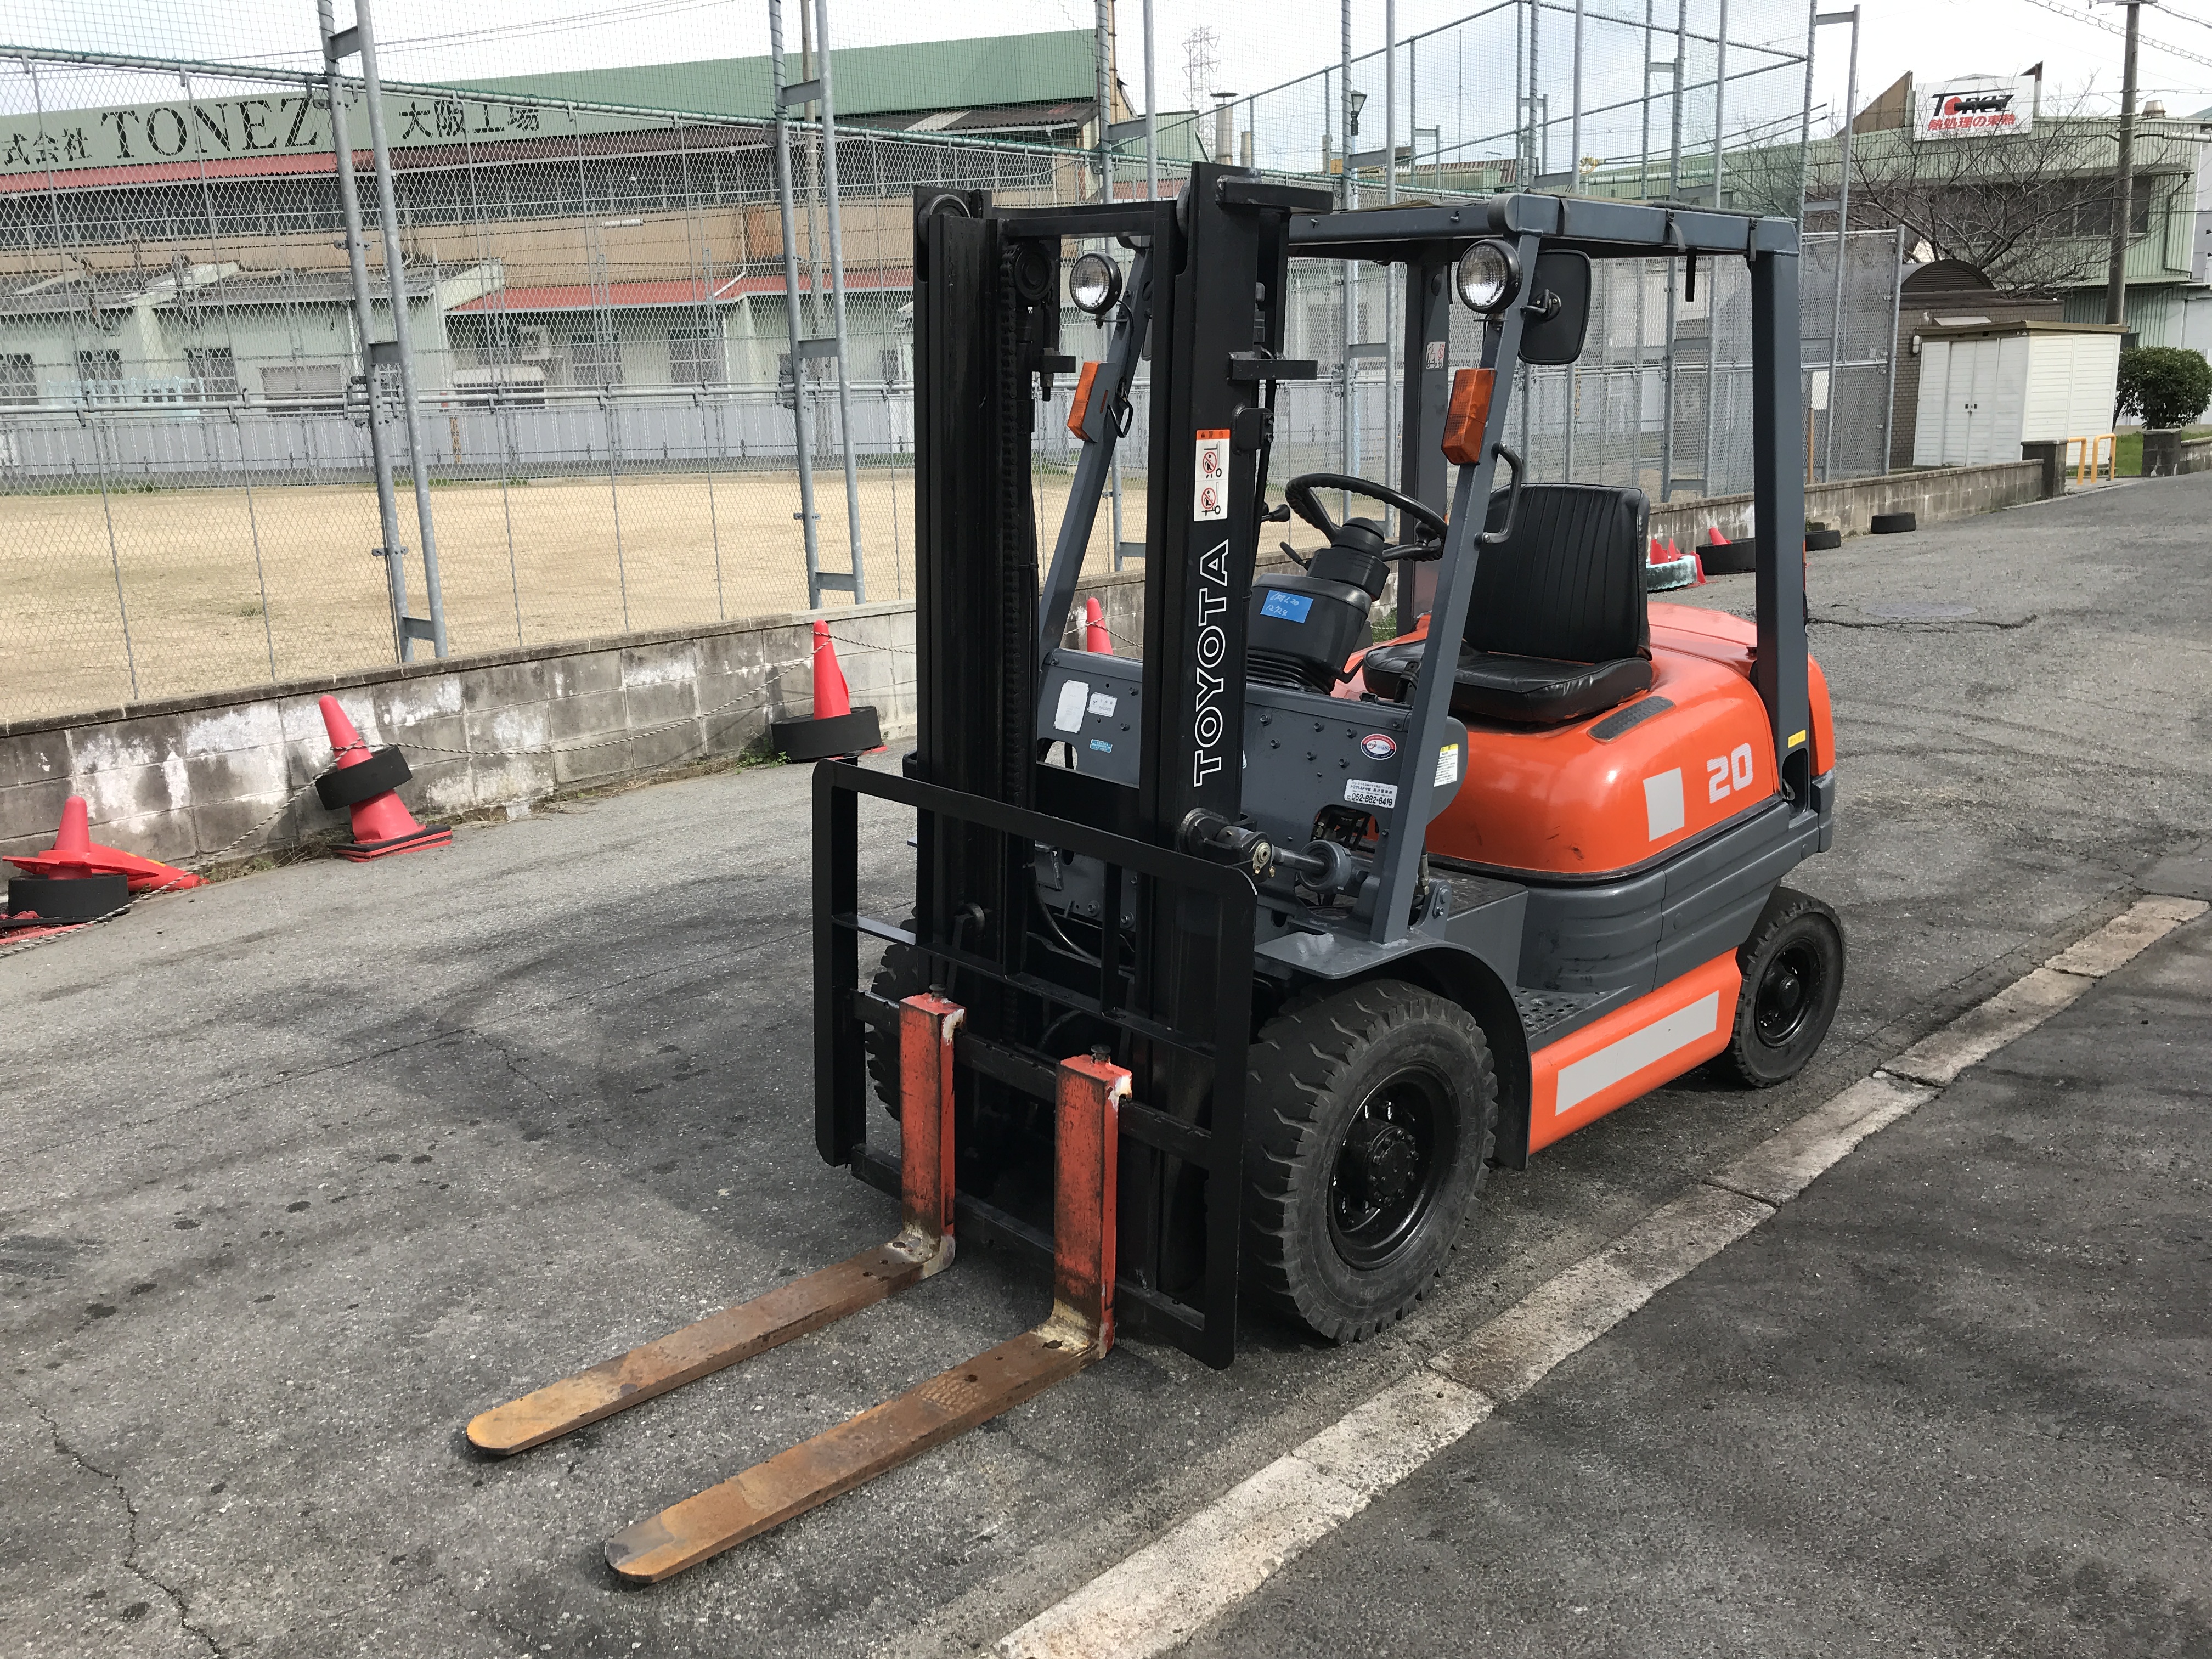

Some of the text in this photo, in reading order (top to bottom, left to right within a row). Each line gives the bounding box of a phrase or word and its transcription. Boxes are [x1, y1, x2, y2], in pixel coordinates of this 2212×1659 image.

[101, 96, 318, 159] TONEZ
[1194, 539, 1229, 787] TOYOTA
[1706, 743, 1753, 804] 20
